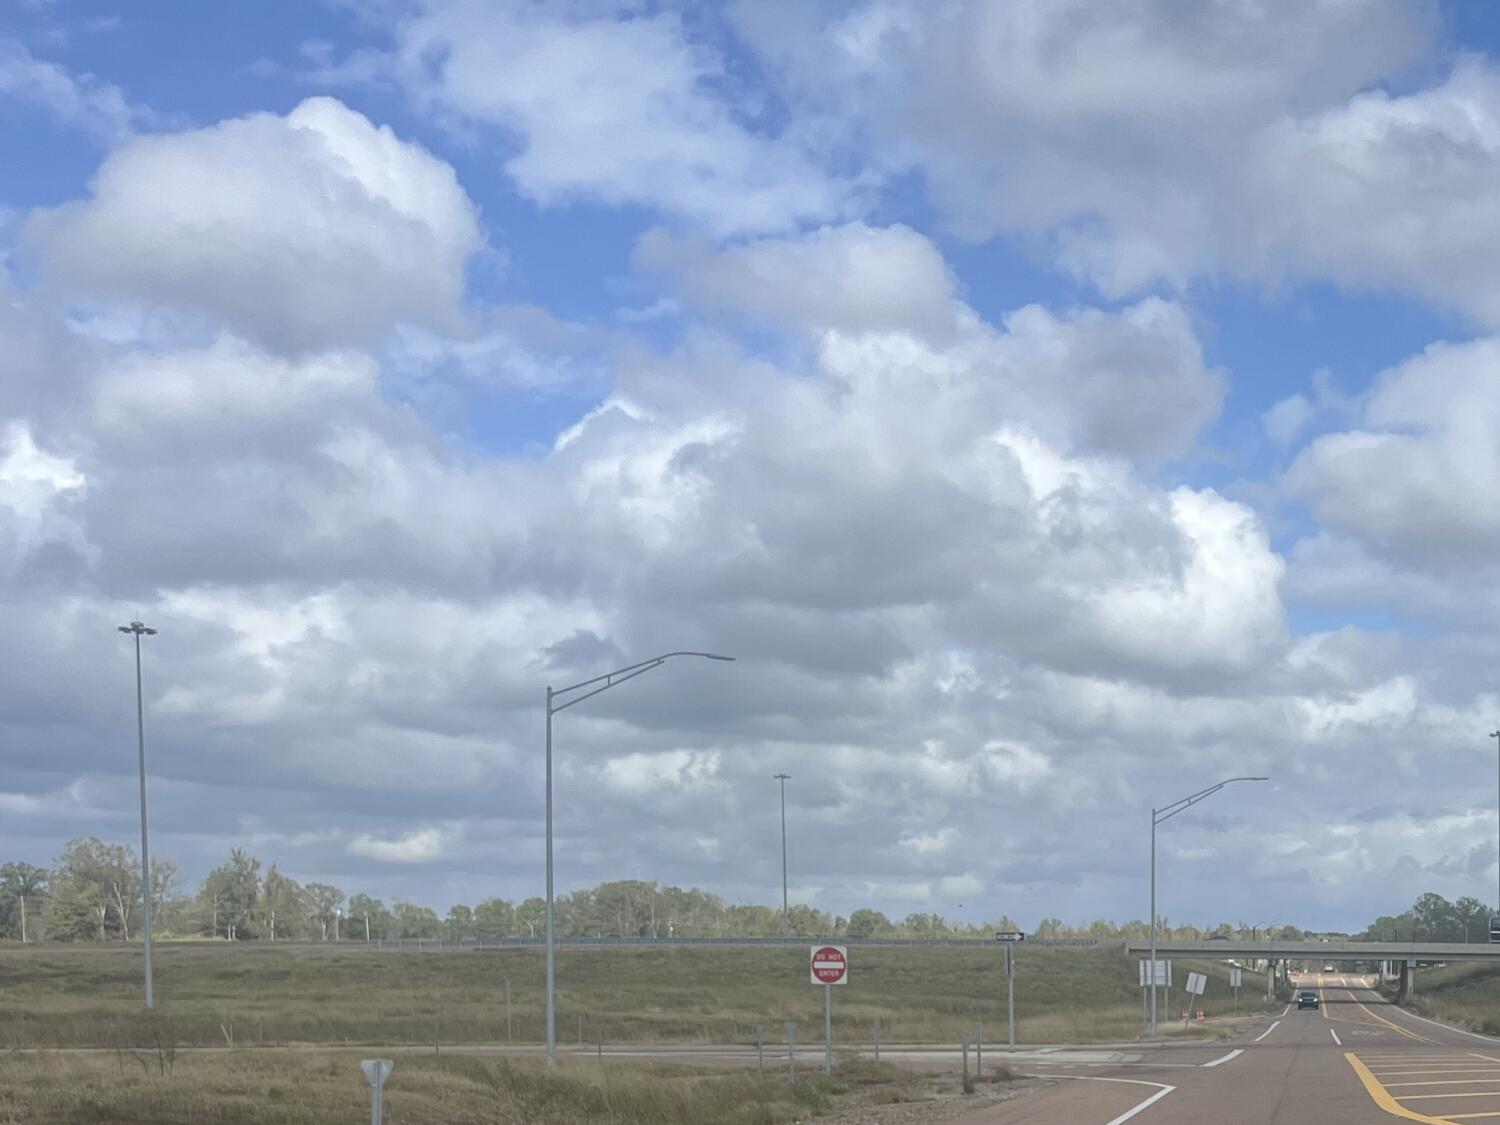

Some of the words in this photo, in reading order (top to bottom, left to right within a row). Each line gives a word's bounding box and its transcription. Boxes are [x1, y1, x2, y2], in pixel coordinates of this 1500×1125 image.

[816, 953, 825, 961] DO
[828, 953, 841, 961] NOT
[819, 969, 839, 977] ENTER
